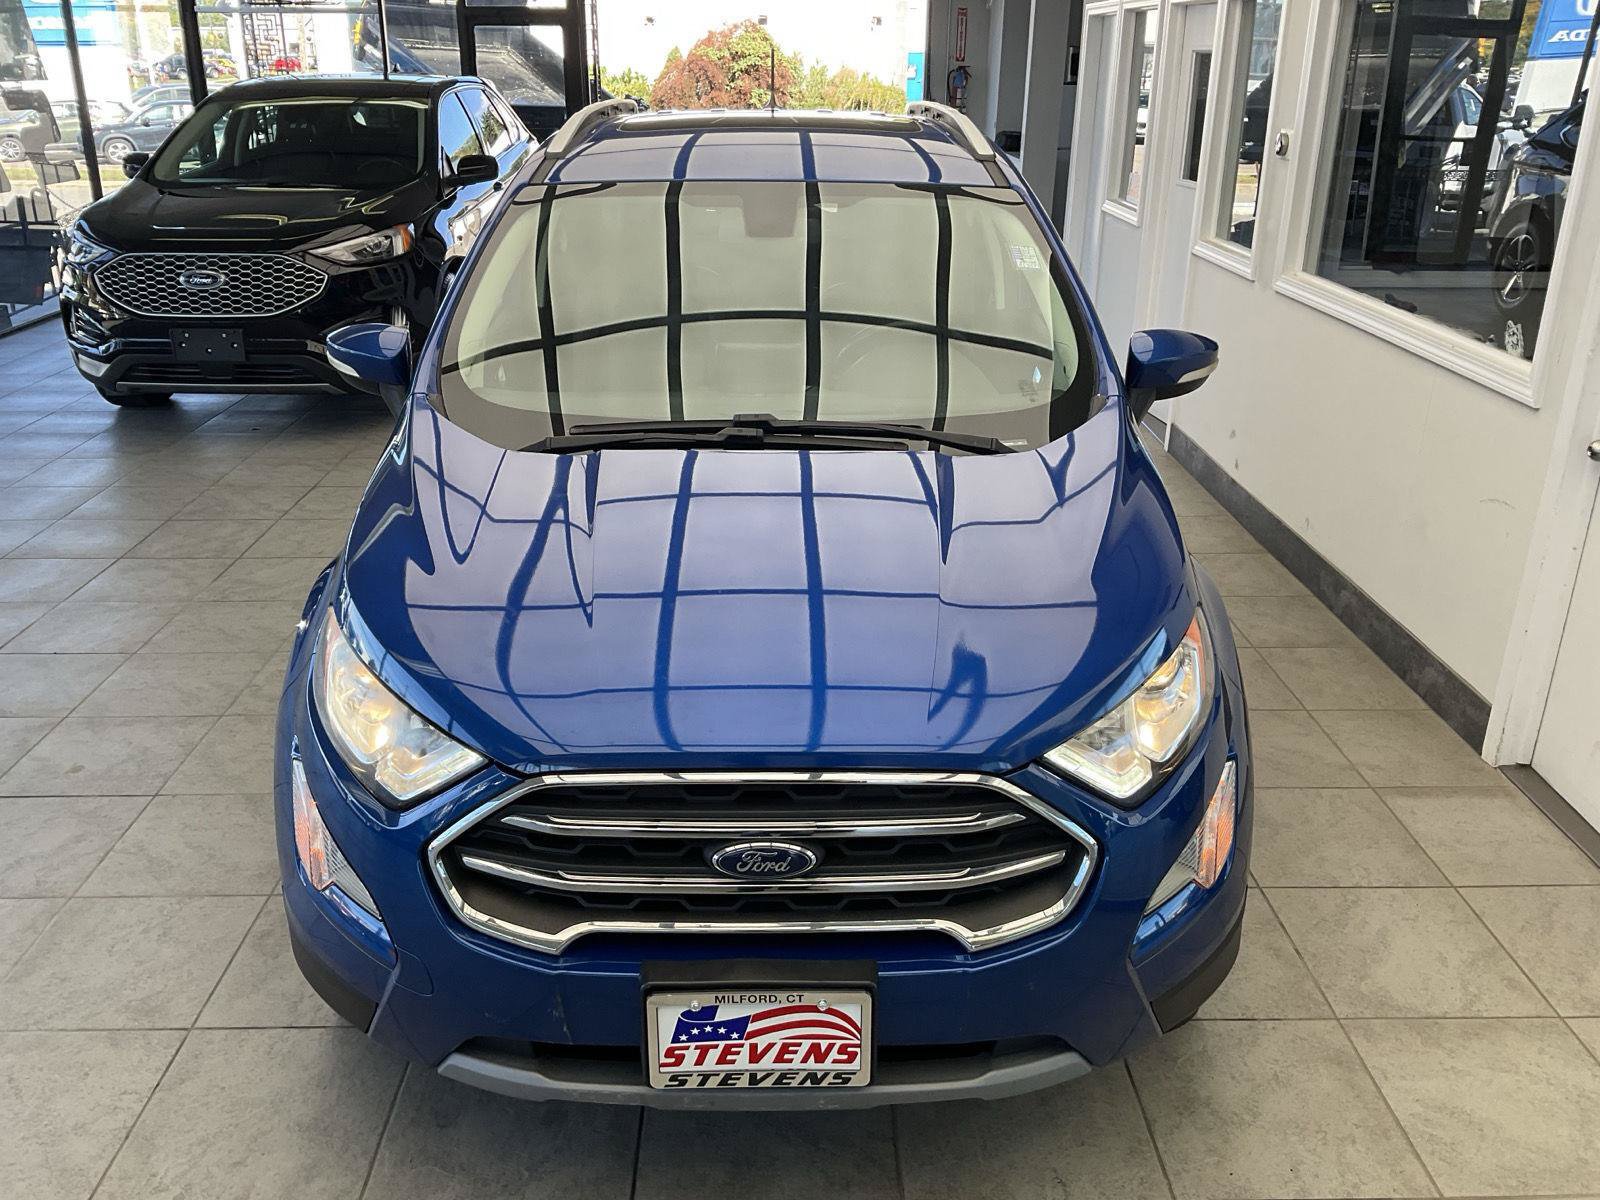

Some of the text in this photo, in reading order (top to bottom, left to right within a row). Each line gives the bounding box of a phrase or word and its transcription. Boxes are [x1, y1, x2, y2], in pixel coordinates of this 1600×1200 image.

[736, 850, 791, 873] Ford
[713, 993, 805, 1005] MILFORD, CT
[659, 1042, 862, 1068] STEVENS
[663, 1071, 858, 1088] STEVENS
